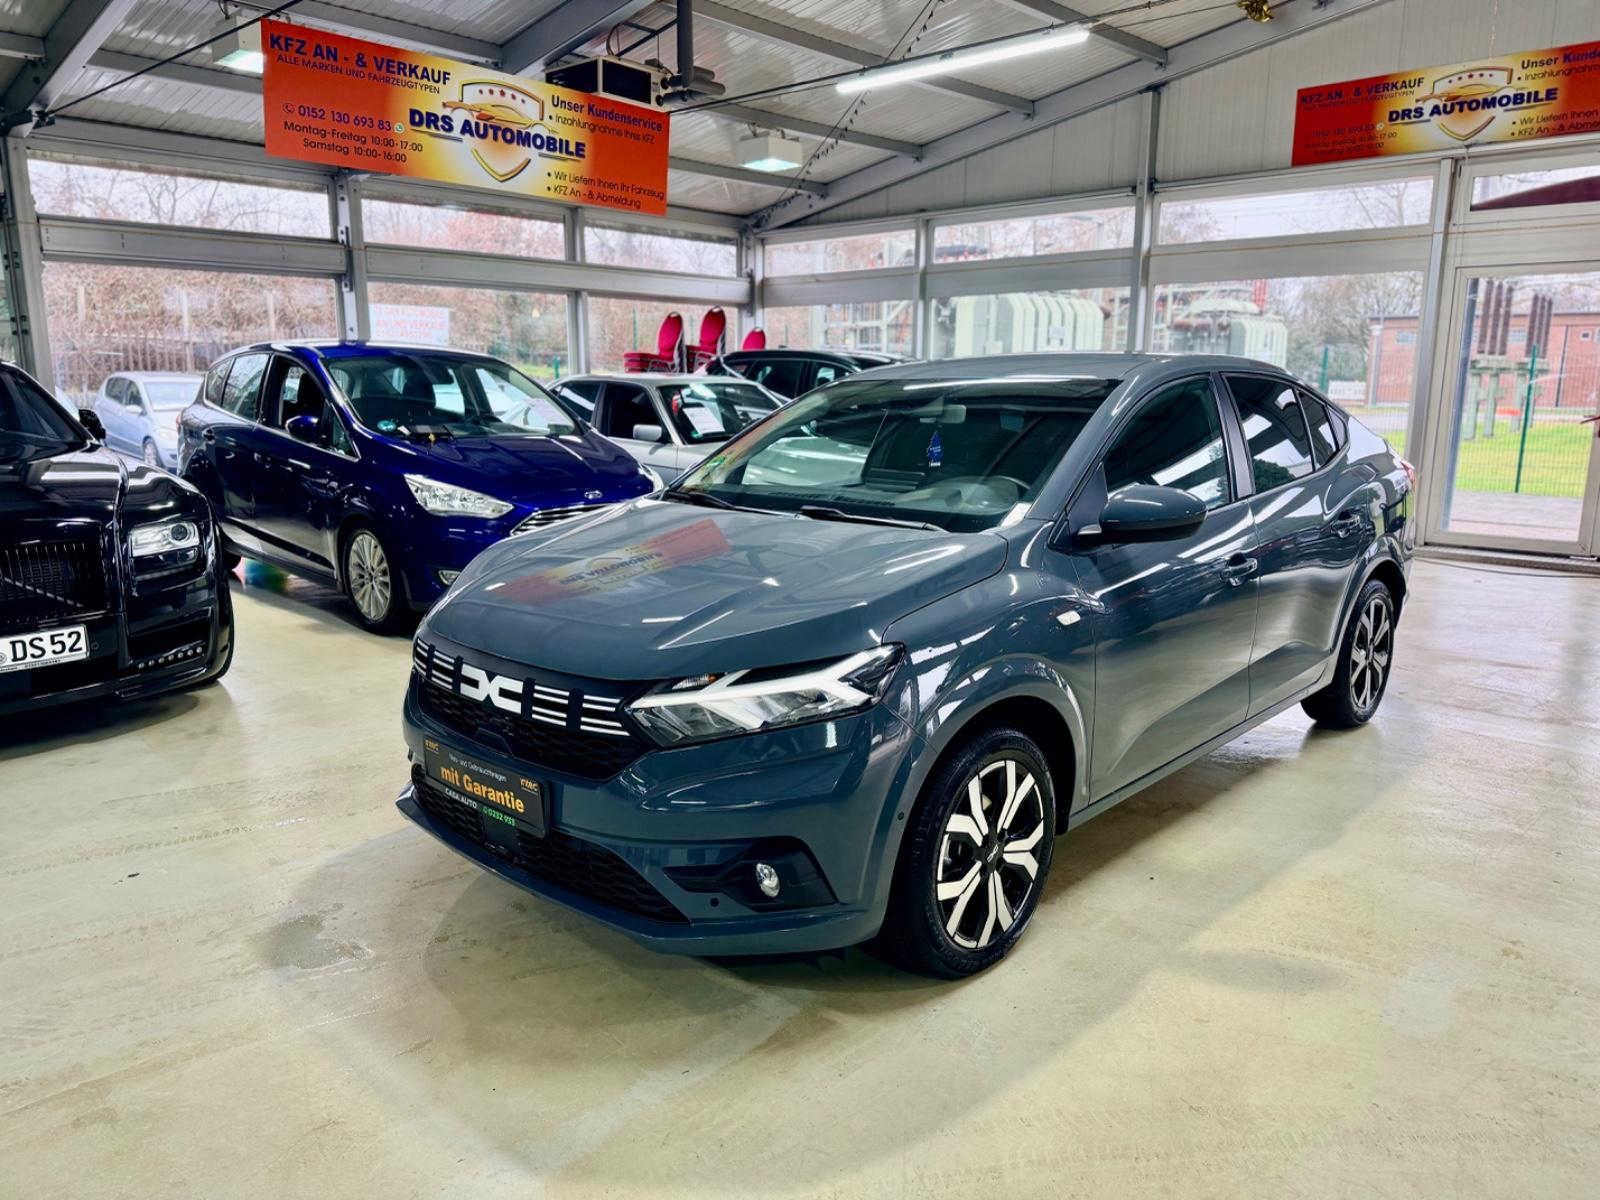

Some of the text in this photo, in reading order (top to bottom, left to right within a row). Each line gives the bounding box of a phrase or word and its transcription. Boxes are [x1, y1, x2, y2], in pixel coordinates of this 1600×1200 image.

[269, 33, 307, 55] KFZ
[313, 44, 338, 62] AN
[355, 53, 368, 68] &
[373, 55, 451, 85] VERKAUF
[1521, 57, 1559, 70] Unser
[277, 54, 440, 94] ALLE MARKEN UND FAHRZEUGTYPEN
[1301, 92, 1323, 104] KFZ
[1327, 90, 1343, 101] AN
[1367, 77, 1424, 95] VERKAUF
[298, 104, 391, 132] 0152 130 693 83
[552, 95, 663, 132] Unser Kundenservice
[1388, 88, 1558, 122] DRS AUTOMOBILE
[284, 120, 367, 145] Montag-Freitag
[409, 108, 586, 159] DRS AUTOMOBILE
[556, 114, 622, 137] Inzahlungnahme
[1518, 128, 1535, 136] KFZ
[1536, 126, 1549, 134] An
[1520, 117, 1534, 125] Wir
[303, 138, 350, 155] Samstag
[554, 171, 567, 180] Wir
[569, 173, 596, 187] Liefern
[553, 185, 568, 196] KFZ
[569, 188, 581, 198] An
[596, 191, 641, 209] Abmeldung
[9, 631, 82, 662] DS 52
[440, 766, 525, 813] mit Garantie
